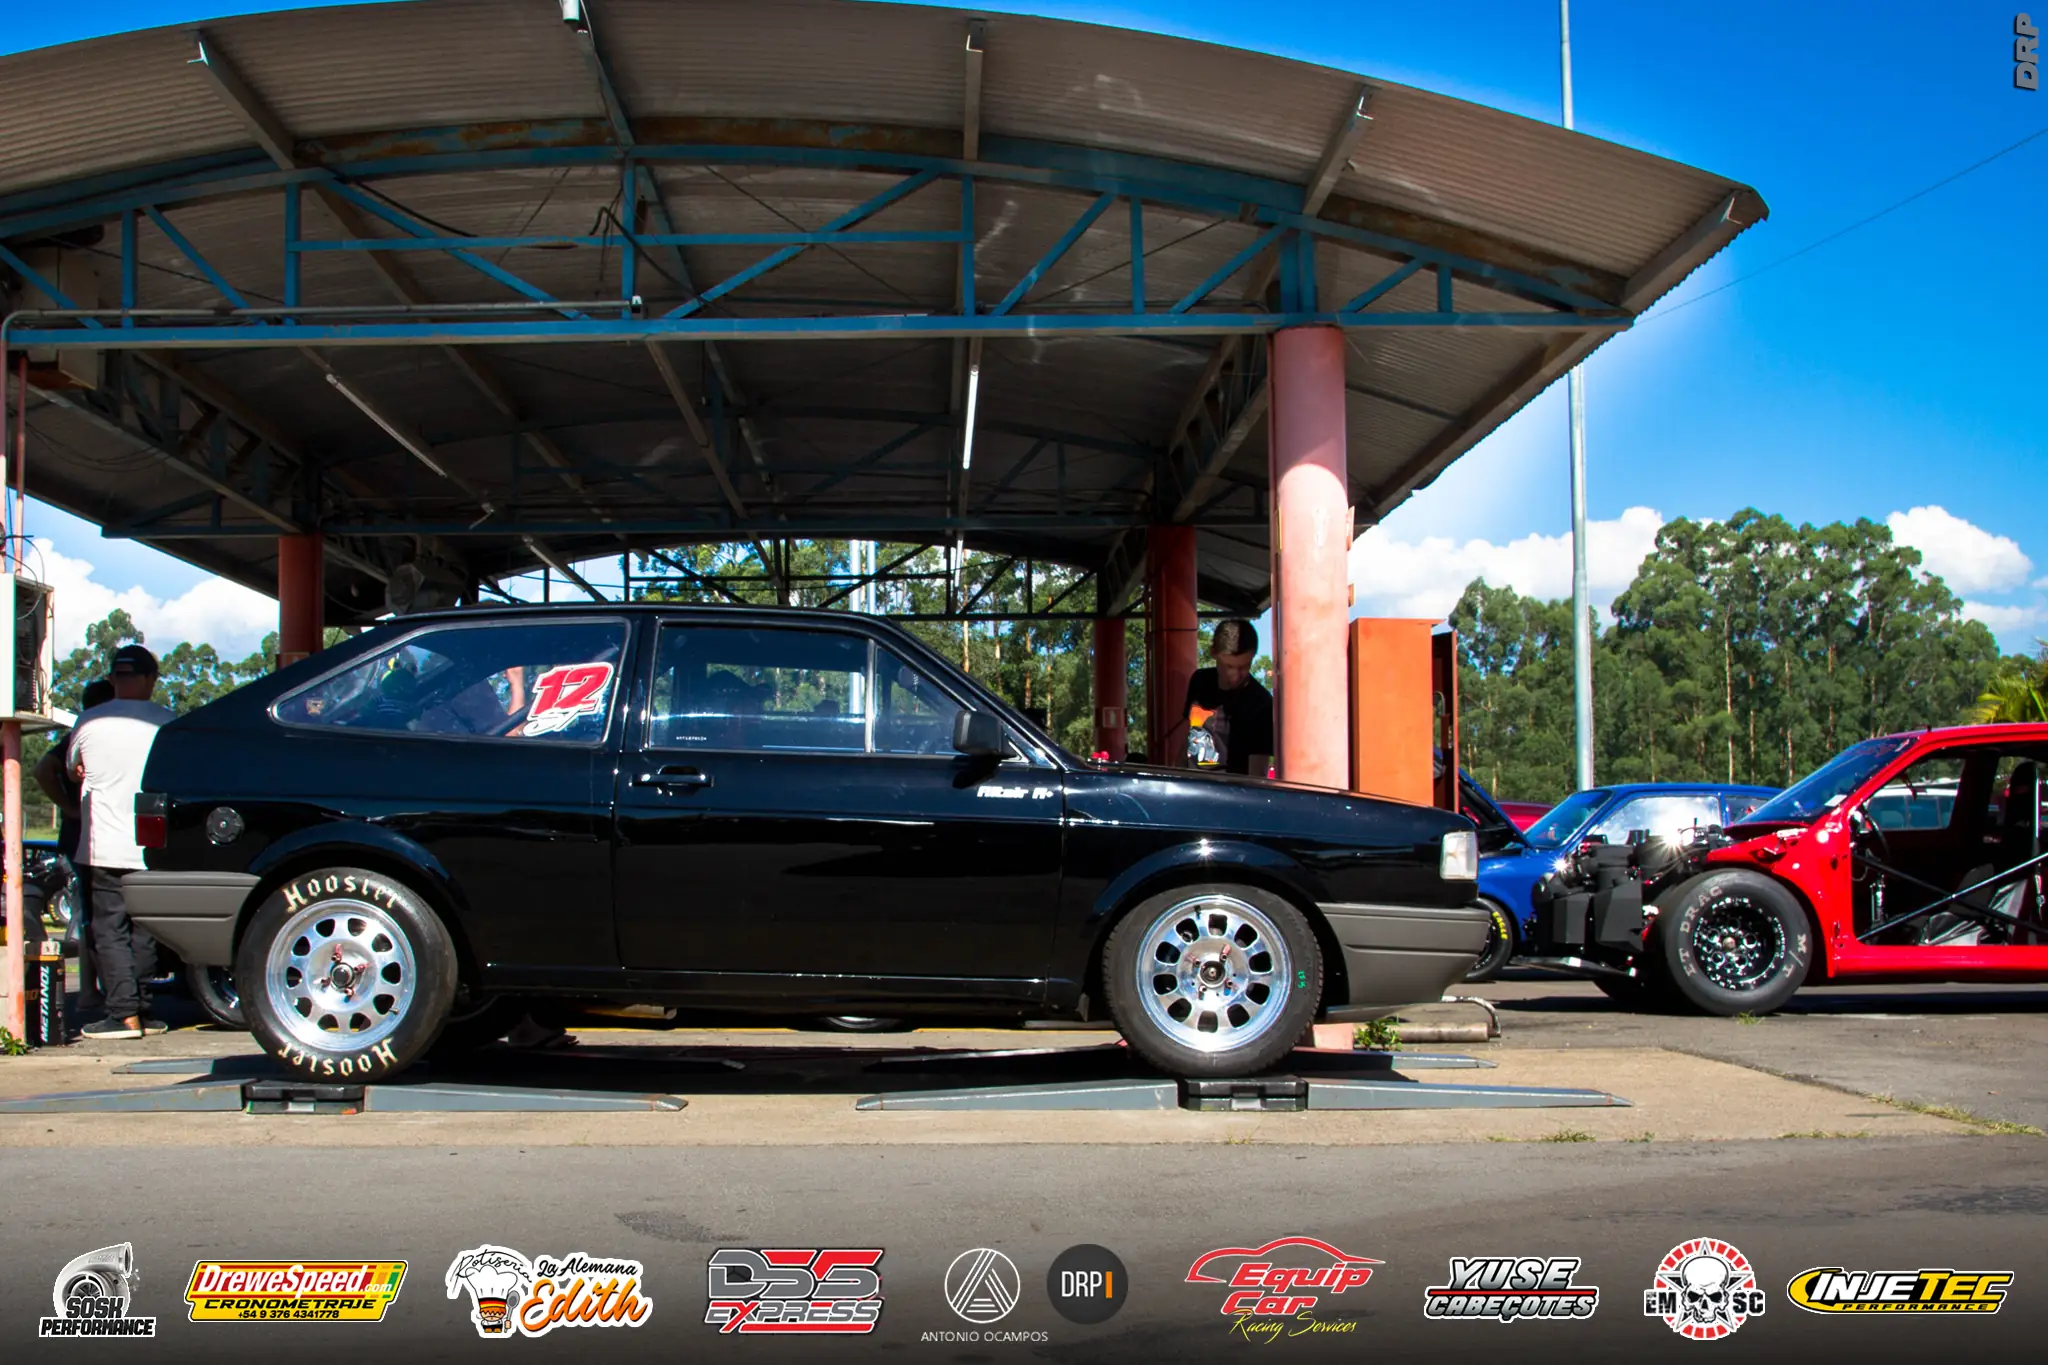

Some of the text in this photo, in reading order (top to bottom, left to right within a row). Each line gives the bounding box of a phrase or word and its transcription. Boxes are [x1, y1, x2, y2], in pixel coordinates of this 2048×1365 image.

[533, 663, 613, 716] 12
[1679, 886, 1723, 934] DRAG
[1782, 934, 1807, 978] M/T
[40, 965, 50, 1043] METANOL
